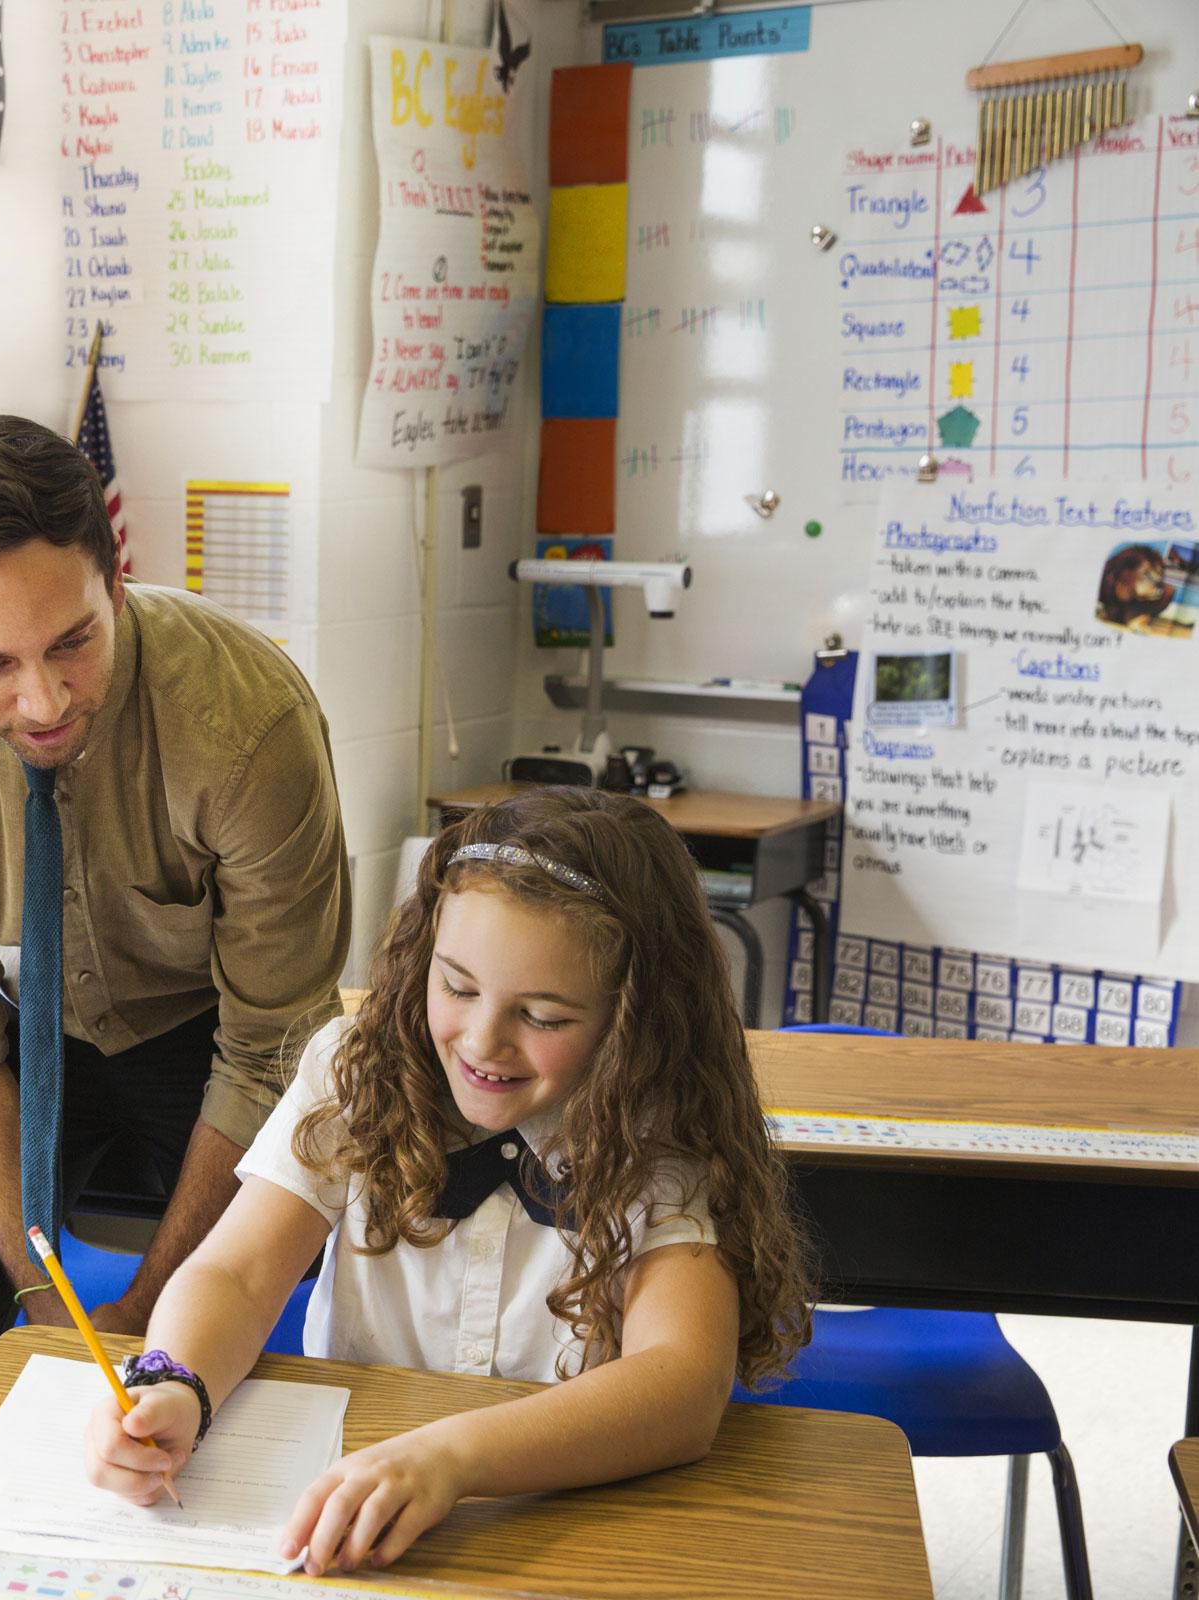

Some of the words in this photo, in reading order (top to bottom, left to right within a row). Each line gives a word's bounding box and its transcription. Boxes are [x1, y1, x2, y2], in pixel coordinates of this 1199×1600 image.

[391, 47, 433, 128] BC
[846, 183, 929, 230] Triangle
[1010, 165, 1048, 218] 3
[1008, 238, 1041, 275] 4
[840, 312, 905, 343] Square
[1010, 298, 1030, 322] 4
[842, 365, 924, 402] Rectangle
[1010, 354, 1031, 384] 4
[843, 414, 928, 447] Pentagon
[1011, 406, 1030, 436] 5
[950, 490, 1049, 523] Nonfiction
[1055, 495, 1098, 525] Text
[1113, 497, 1194, 528] features
[885, 521, 999, 554] Photographs
[891, 553, 932, 576] taken
[927, 614, 955, 639] SEE
[1016, 647, 1101, 682] Captions
[818, 721, 826, 740] 1
[1004, 711, 1028, 733] tell
[1145, 722, 1167, 741] the
[815, 751, 836, 769] 11
[863, 729, 936, 760] Diagrams
[1104, 750, 1186, 781] picture
[839, 940, 864, 964] 72
[872, 948, 896, 972] 73
[944, 962, 971, 986] 75
[978, 969, 1006, 993] 76
[1020, 974, 1050, 995] 77
[1064, 978, 1091, 1002] 78
[1102, 985, 1129, 1009] 79
[1143, 991, 1170, 1016] 80
[1018, 1006, 1046, 1028] 87
[1056, 1011, 1083, 1034] 88
[1098, 1018, 1125, 1041] 89
